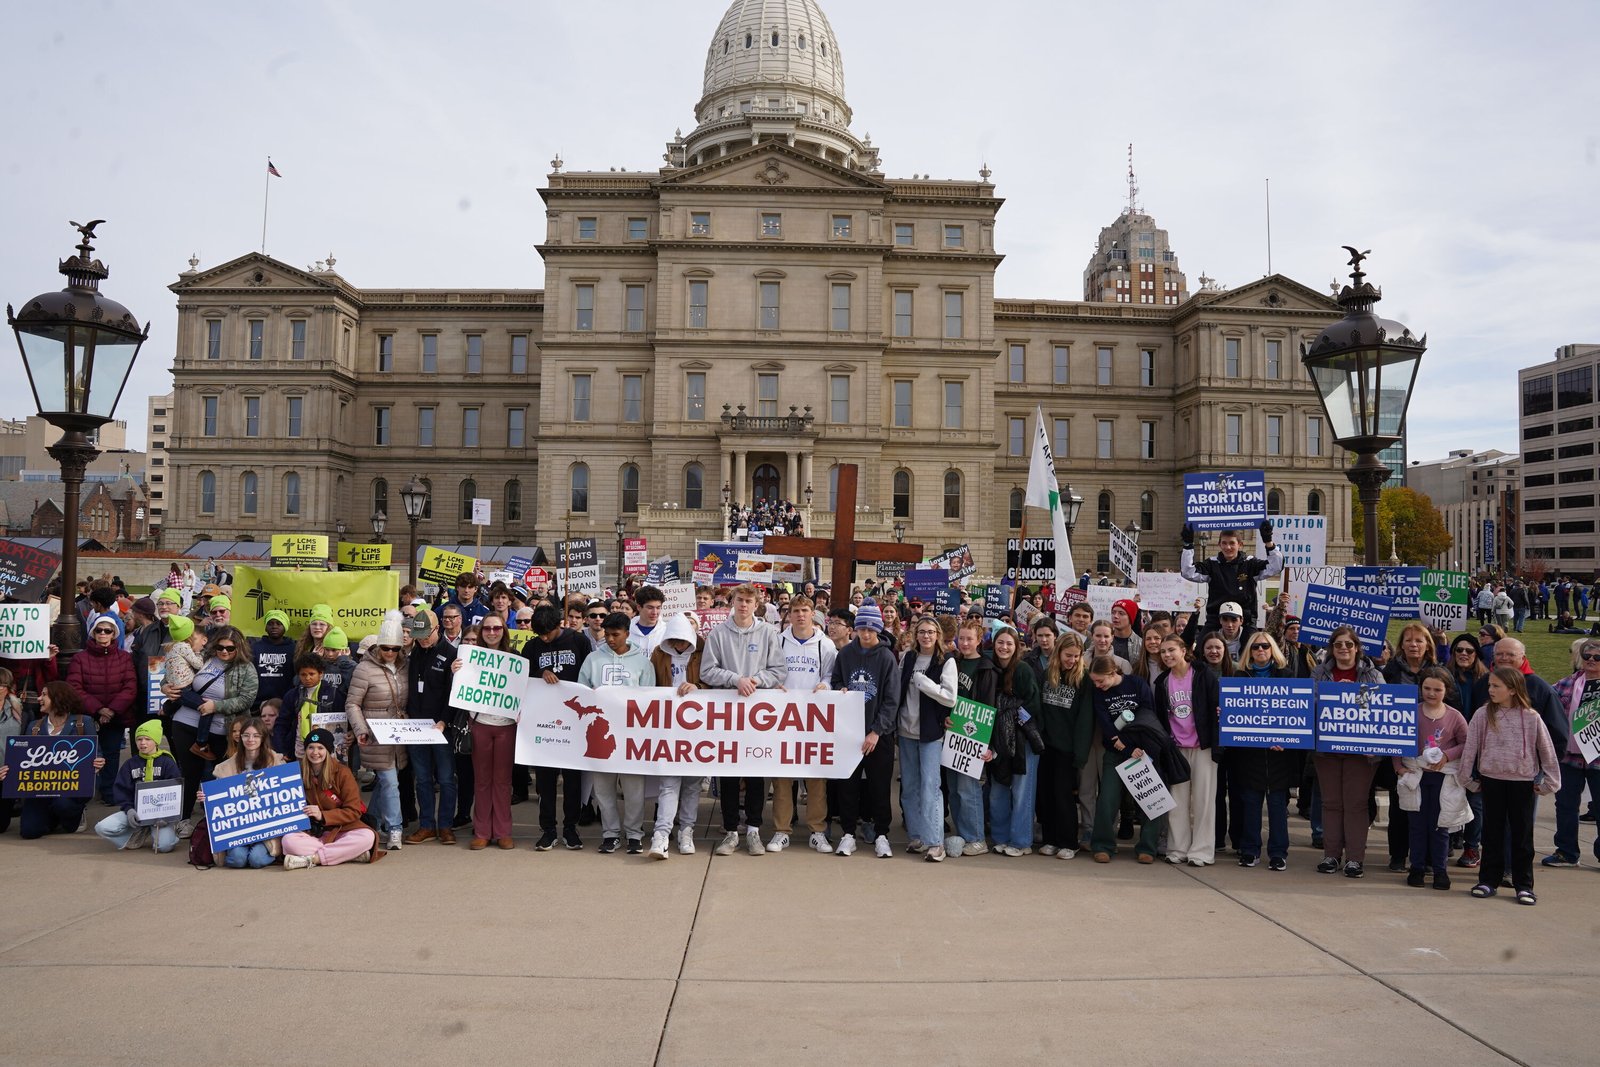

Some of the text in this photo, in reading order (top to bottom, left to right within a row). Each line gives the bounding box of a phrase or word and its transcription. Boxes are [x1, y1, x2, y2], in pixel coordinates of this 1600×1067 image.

[1188, 491, 1263, 504] ABORTION
[1187, 503, 1264, 515] UNTHINKABLE
[1198, 521, 1254, 529] PROTECTLIFEMI.ORG
[1283, 533, 1299, 541] THE
[560, 540, 591, 550] HUMAN
[1008, 539, 1056, 551] ABORTIO
[1121, 535, 1126, 545] IS
[1127, 540, 1137, 556] THE
[0, 541, 59, 569] BORTION
[560, 552, 592, 562] RGHTS
[929, 545, 968, 566] Love Family
[1031, 553, 1042, 566] IS
[1112, 540, 1133, 566] AUTHOR
[445, 562, 463, 571] LIFE
[447, 555, 465, 565] LCMS
[1114, 555, 1131, 578] OF LIFE
[1284, 556, 1311, 565] TION
[21, 573, 36, 582] are
[560, 570, 596, 580] UNBORN
[948, 571, 960, 581] ose
[1008, 567, 1056, 580] GENOCID
[1289, 566, 1346, 586] VERY BAB
[1422, 573, 1466, 590] LOVE LIFE
[936, 590, 950, 598] Life.
[1054, 602, 1071, 613] BEA
[1328, 593, 1369, 609] HUMAN
[0, 608, 40, 621] AY TO
[338, 608, 386, 618] CHURCH
[1309, 602, 1349, 617] RIGHTS
[1350, 610, 1384, 624] BEGIN
[1424, 602, 1462, 618] CHOOSE
[705, 613, 728, 621] THEIR
[1432, 619, 1452, 631] LIFE
[0, 640, 44, 654] RTION
[259, 653, 287, 664] MUSTANGS
[468, 649, 523, 674] PRAY TO
[479, 670, 507, 689] END
[1244, 685, 1289, 696] HUMAN
[457, 685, 521, 711] ABORTION
[1225, 698, 1308, 709] RIGHTS BEGIN
[626, 700, 835, 732] MICHIGAN
[953, 700, 995, 727] LOVE LIFE
[1320, 706, 1415, 724] ABORTION
[1573, 701, 1595, 721] LOVE
[1227, 714, 1306, 727] CONCEPTION
[1319, 722, 1416, 737] UNTHINKABLE
[1579, 720, 1600, 744] CHOO
[1233, 735, 1300, 743] PROTECTLIFEMI.ORG
[626, 738, 834, 765] MARCH FOR LIFE
[948, 733, 983, 759] CHOOSE
[1331, 744, 1402, 754] PROTECTLIFEMI.ORG
[20, 745, 79, 769] Love
[952, 753, 971, 773] LIFE
[18, 770, 79, 780] IS ENDING
[1127, 764, 1150, 783] Stand
[17, 781, 79, 791] ABORTION
[1134, 776, 1153, 791] With
[142, 791, 177, 804] OUR SAVIOR
[1135, 783, 1164, 801] Women
[211, 786, 304, 820] ABORTION
[212, 800, 307, 832] UNTHINKABLE
[228, 825, 299, 848] PROTECTLIFEMI.ORG
